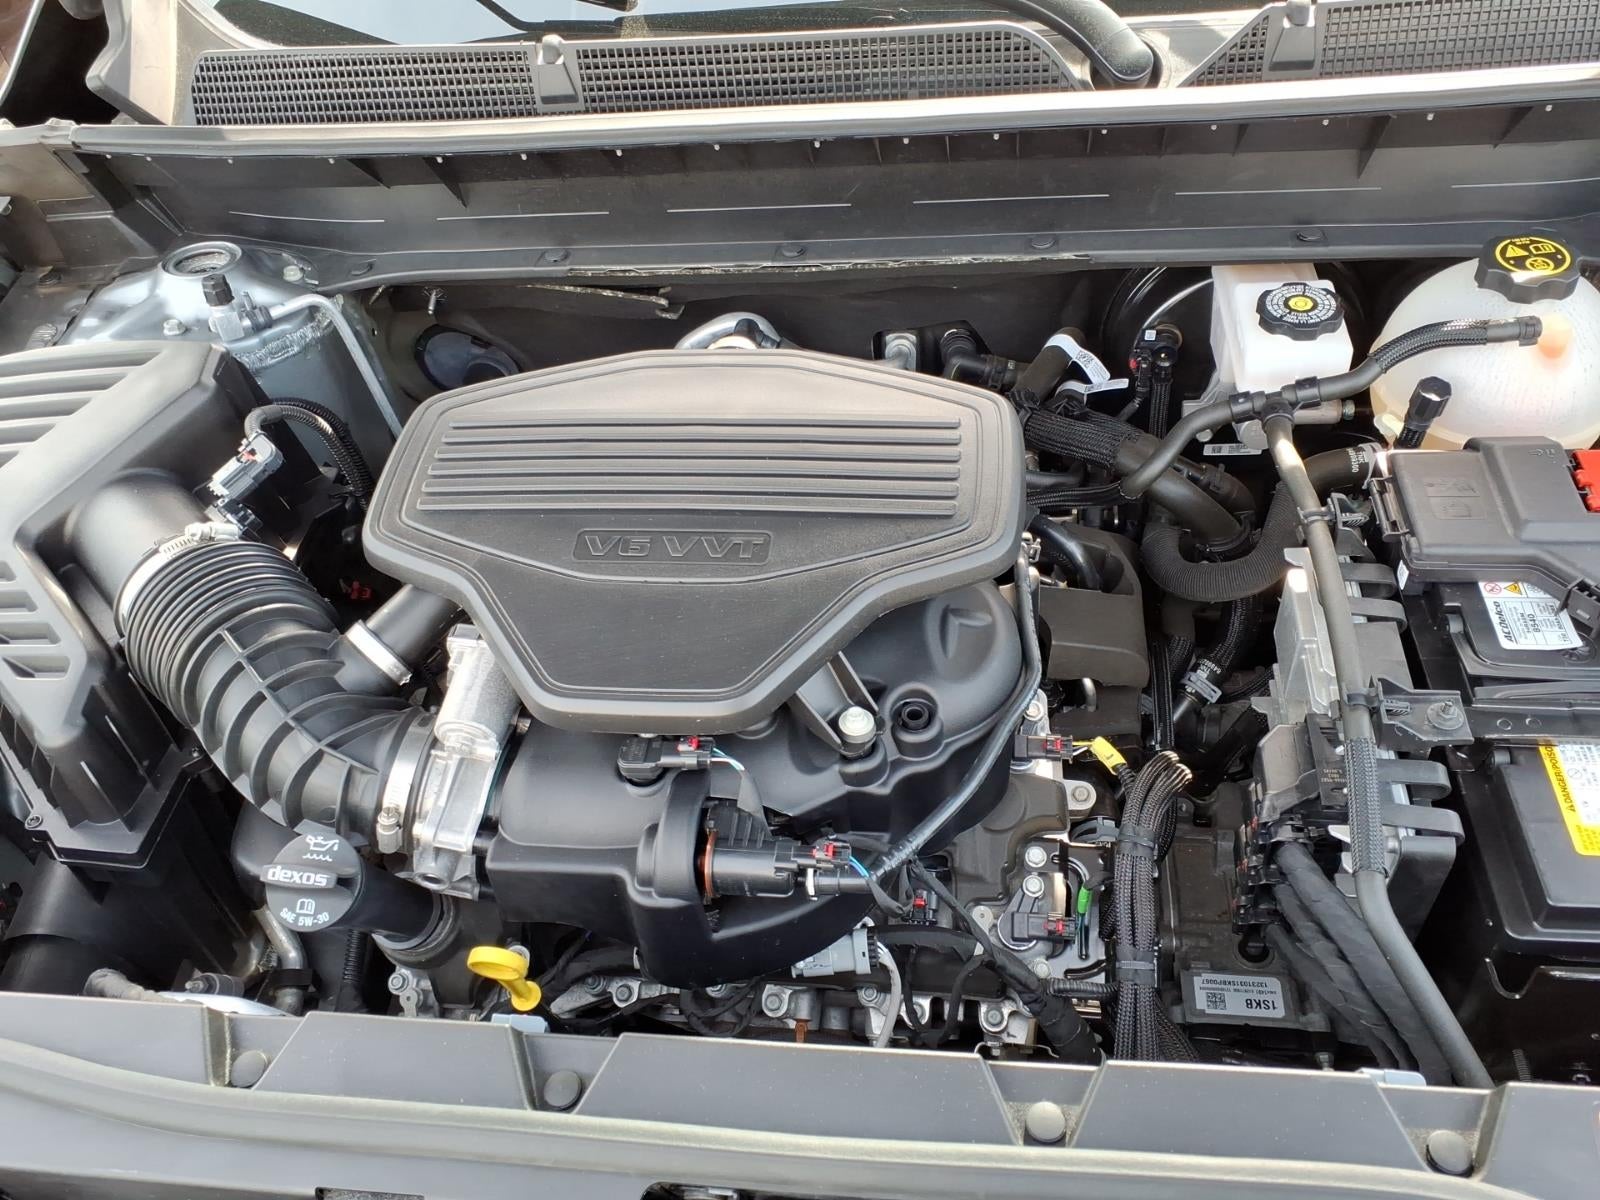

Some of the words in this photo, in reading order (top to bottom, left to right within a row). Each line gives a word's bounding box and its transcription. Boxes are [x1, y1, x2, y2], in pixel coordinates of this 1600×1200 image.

[585, 536, 650, 556] V6
[663, 536, 765, 558] VVT
[1493, 601, 1514, 643] ACDelco
[1545, 746, 1573, 804] DANGER/POISO
[267, 865, 331, 887] dexos
[280, 907, 296, 923] SAE
[298, 912, 329, 926] 5W-30
[1245, 998, 1278, 1010] 1SKB
